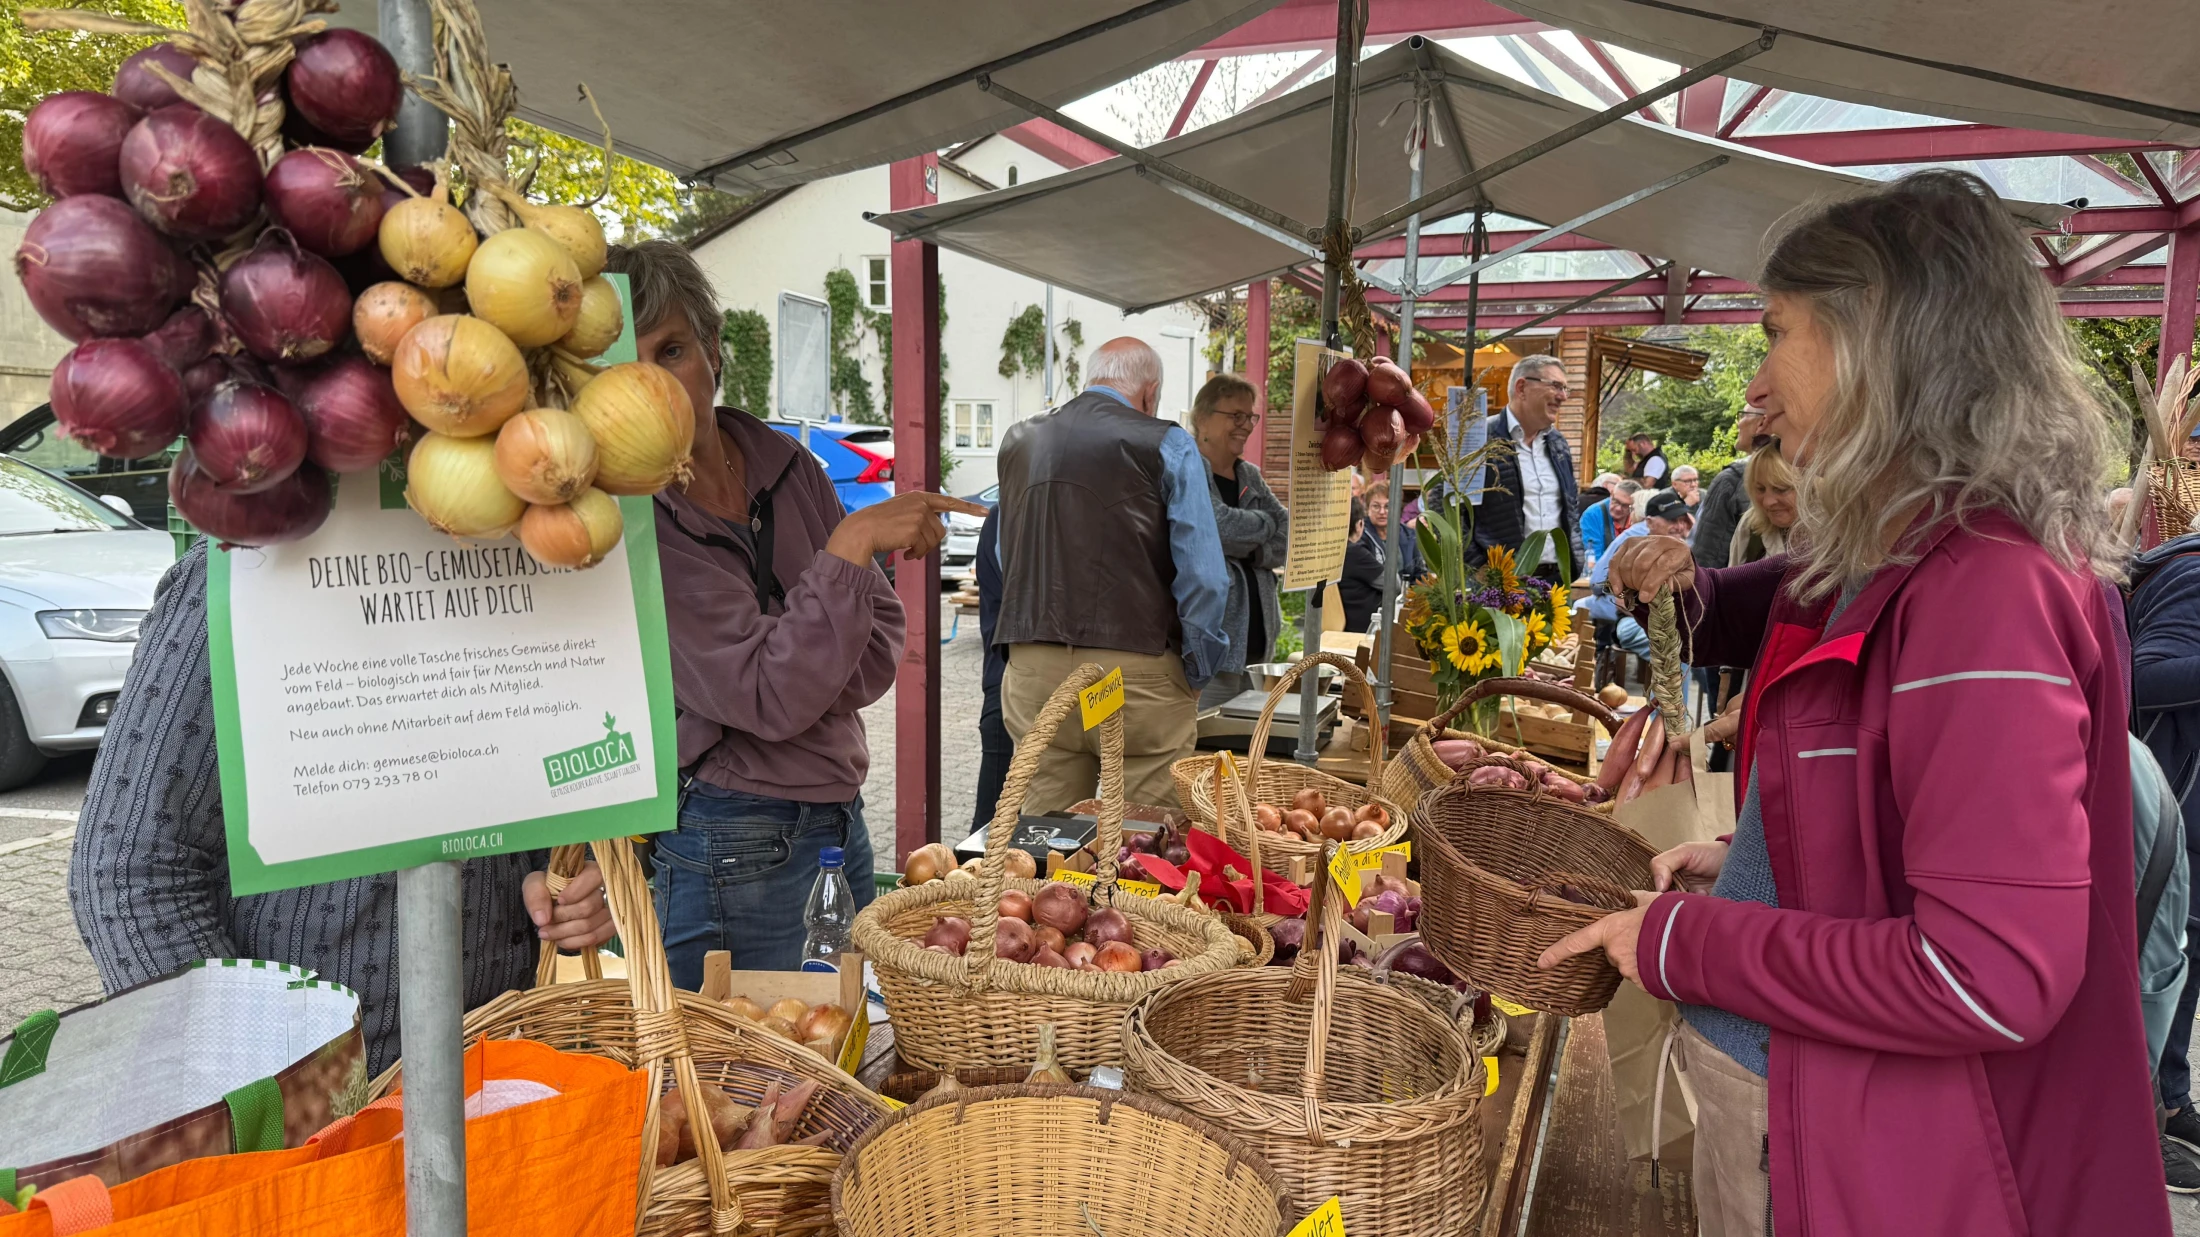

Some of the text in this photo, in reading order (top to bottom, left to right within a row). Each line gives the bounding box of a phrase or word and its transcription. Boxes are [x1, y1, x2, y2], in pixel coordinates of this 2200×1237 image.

[309, 554, 371, 589] DEINE
[360, 583, 534, 625] WARTET AUF DICH
[280, 638, 597, 681] Jede Woche eine volle Tasche frisches Gemüse direkt
[285, 685, 312, 695] vom
[315, 678, 343, 693] Feld
[357, 671, 419, 690] biologisch
[422, 667, 447, 682] und
[450, 668, 471, 682] fair
[473, 665, 491, 679] für
[495, 660, 542, 676] Mensch
[545, 656, 567, 671] und
[570, 655, 606, 668] Natur
[287, 677, 544, 716] angebaut. Das erwartet dich als Mitglied.
[289, 700, 582, 742] Neu auch ohne Mitarbeit auf dem Feld möglich.
[294, 744, 500, 778] Melde dich: gemuese@bioloca.ch
[549, 739, 632, 783] BIOLOCA
[294, 769, 439, 797] Telefon 079 293 78 01
[442, 832, 503, 854] BIOLOCA.CH
[1134, 886, 1157, 898] rot
